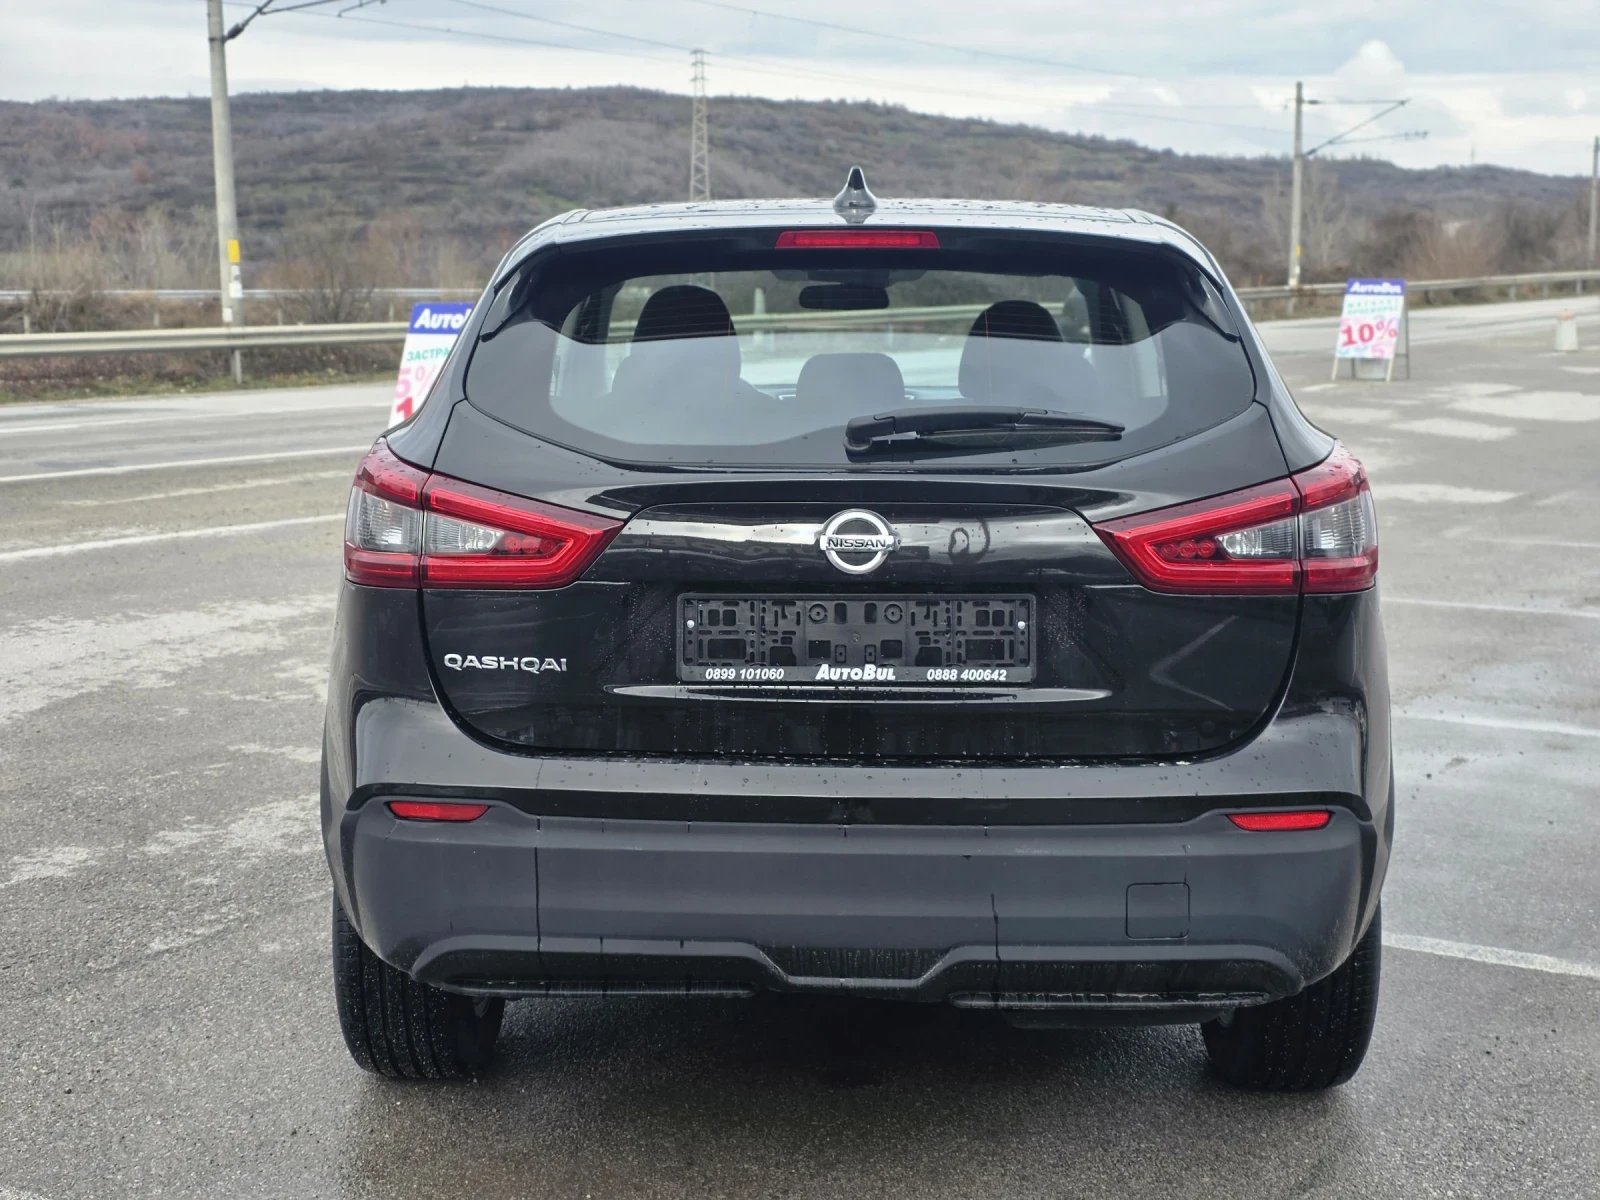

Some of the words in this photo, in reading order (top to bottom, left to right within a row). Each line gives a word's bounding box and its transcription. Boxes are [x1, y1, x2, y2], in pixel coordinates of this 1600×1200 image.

[1341, 320, 1398, 347] 10%
[828, 538, 886, 548] NISSAN
[444, 653, 567, 674] QASHQAI
[705, 668, 736, 680] 0899
[739, 668, 785, 680] 101060
[927, 668, 958, 681] 0888
[960, 668, 1007, 681] 400642
